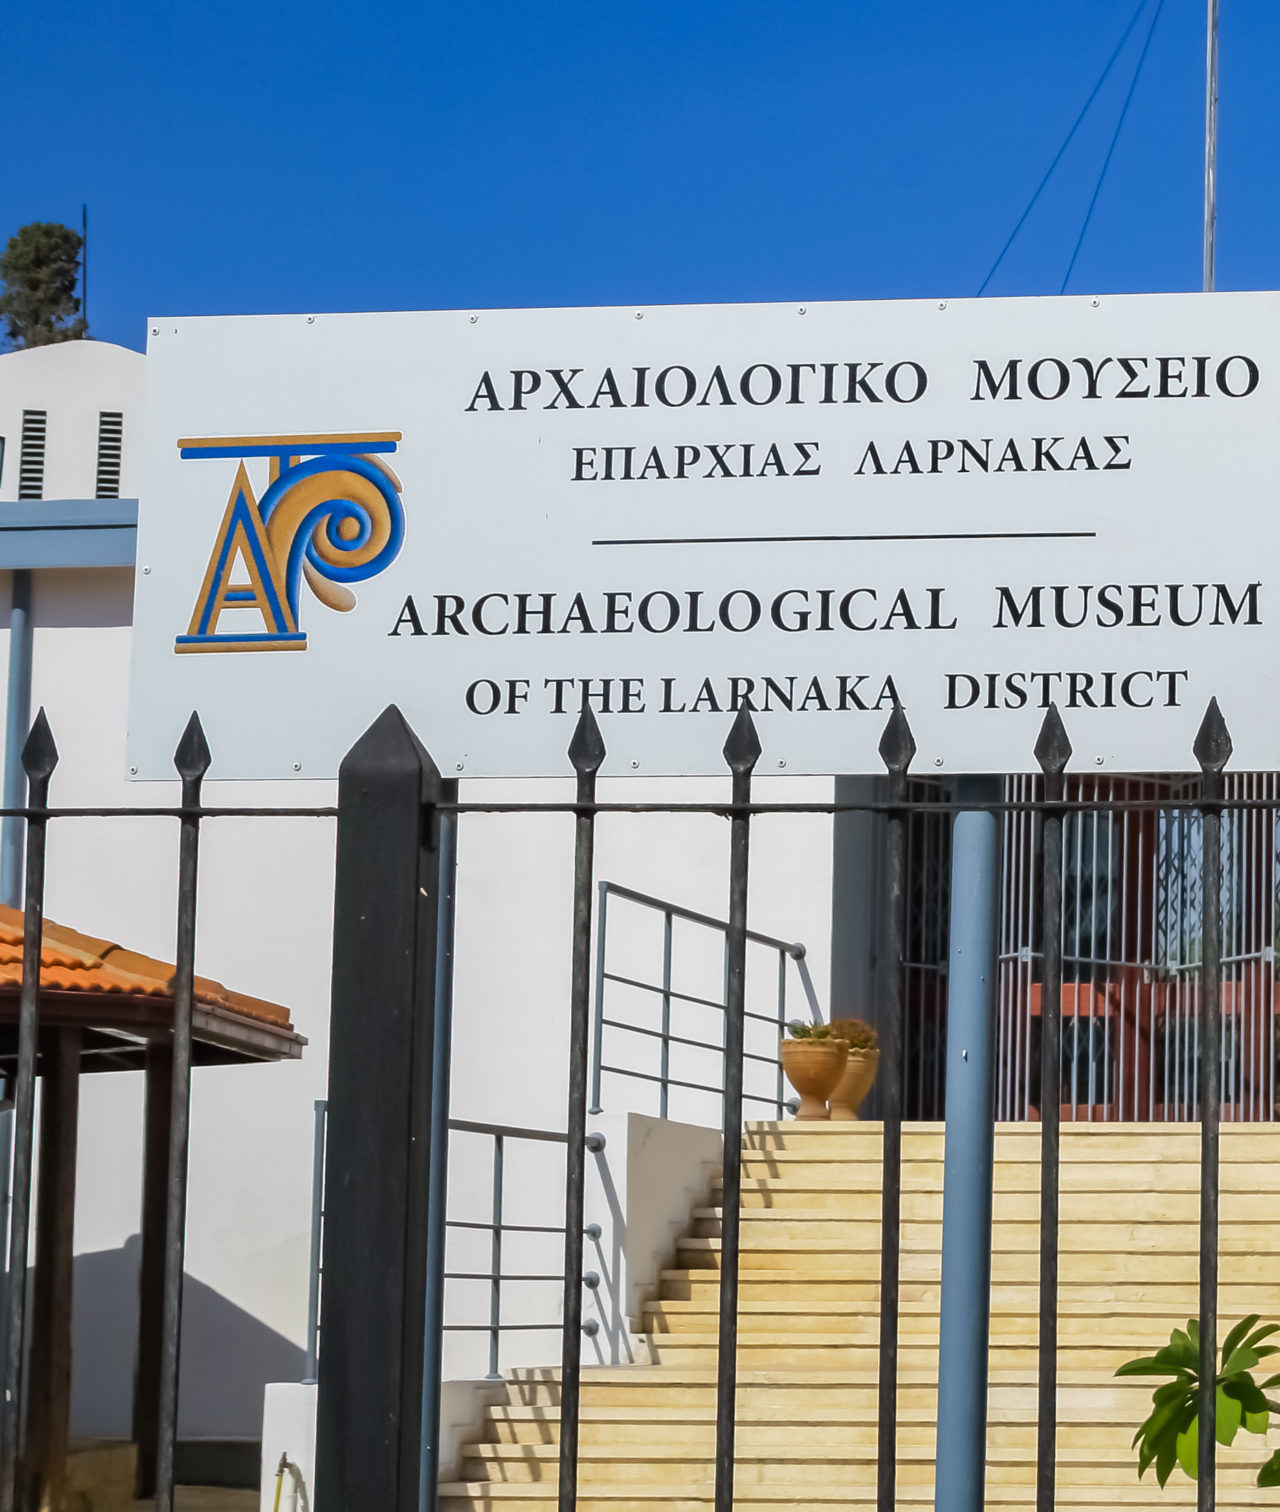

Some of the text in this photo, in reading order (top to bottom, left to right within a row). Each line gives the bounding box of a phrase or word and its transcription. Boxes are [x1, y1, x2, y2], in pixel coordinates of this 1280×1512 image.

[464, 355, 1260, 412] ΑΡΧΑΙΟΛΟΓΙΚΟ ΜΟΥΣΕΙΟ
[570, 435, 1132, 482] ΕΠΑΡΧΙΑΣ ΛΑΡΝΑΚΑΣ
[387, 580, 1263, 637] ARCHAEOLOGICAL MUSEUM
[465, 669, 1189, 716] OF THE LARNAKA DISTRICT
